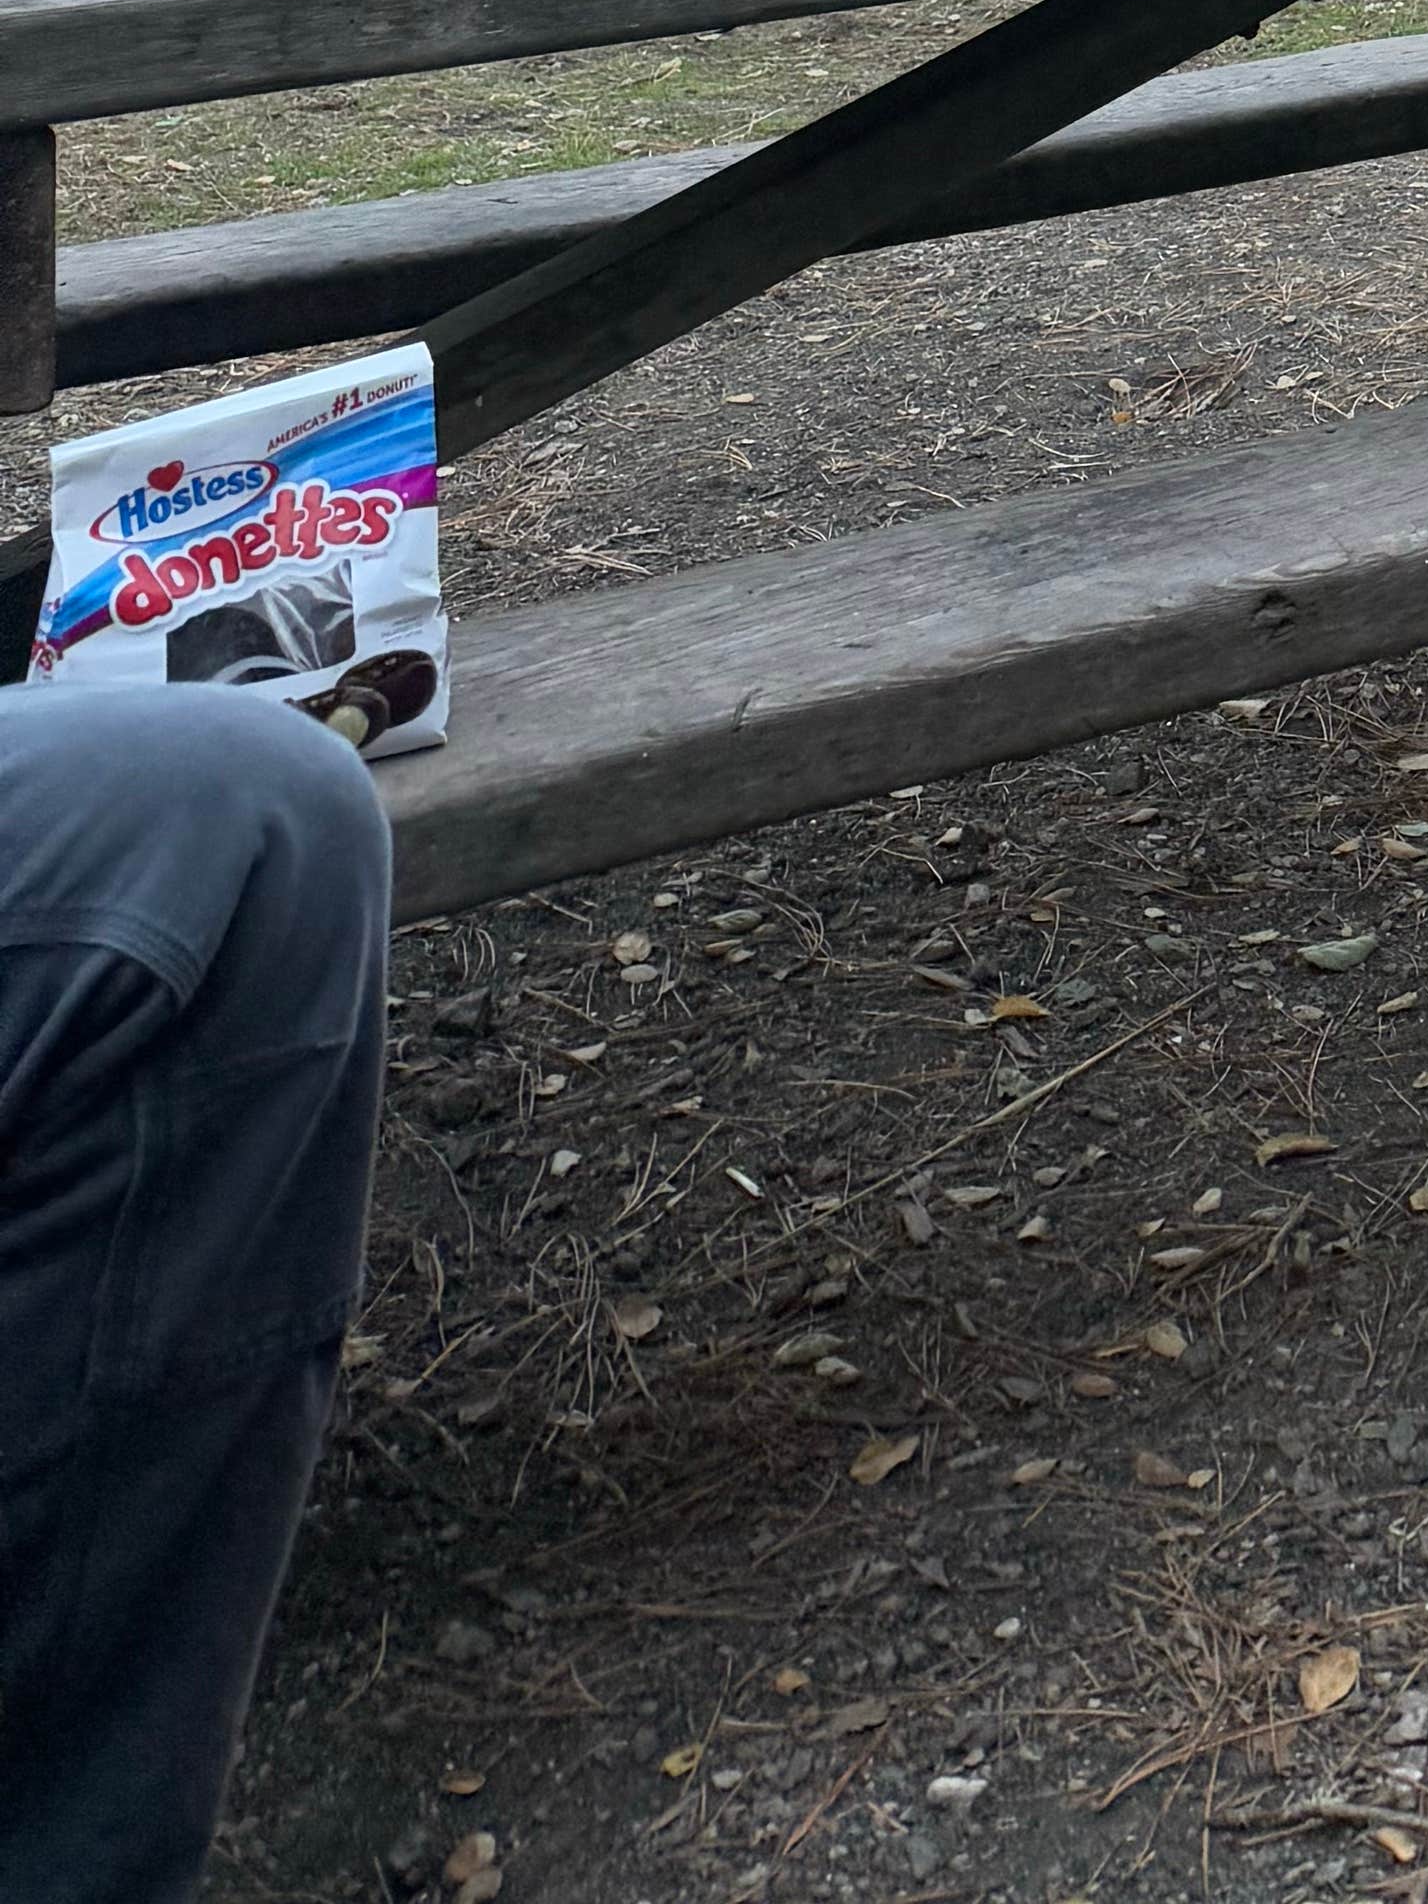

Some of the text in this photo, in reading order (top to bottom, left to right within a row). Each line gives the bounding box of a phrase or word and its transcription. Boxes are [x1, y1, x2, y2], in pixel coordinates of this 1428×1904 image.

[267, 412, 329, 452] AMERICA'S
[331, 386, 364, 418] #1
[118, 466, 264, 538] Hostess
[115, 484, 397, 626] donettes
